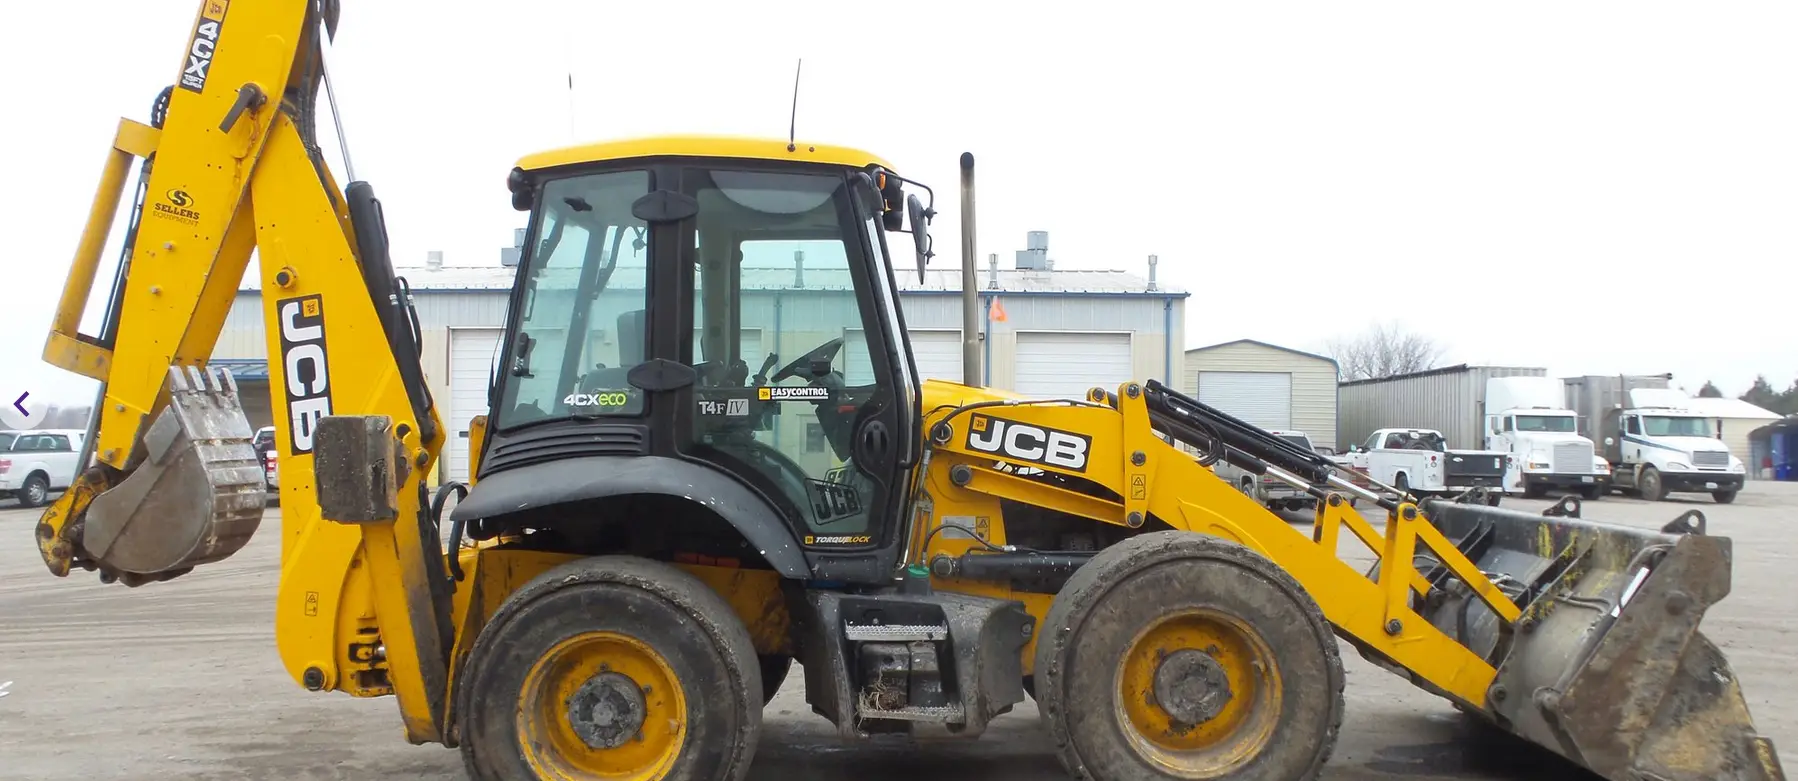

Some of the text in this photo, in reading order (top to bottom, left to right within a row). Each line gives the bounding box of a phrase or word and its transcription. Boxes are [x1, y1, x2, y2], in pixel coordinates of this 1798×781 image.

[184, 21, 219, 79] 4CX
[155, 202, 200, 220] SELLERS
[281, 301, 331, 451] JCB
[771, 387, 829, 397] EASYCONTROL
[969, 420, 1087, 469] JCB
[812, 482, 860, 521] JCB
